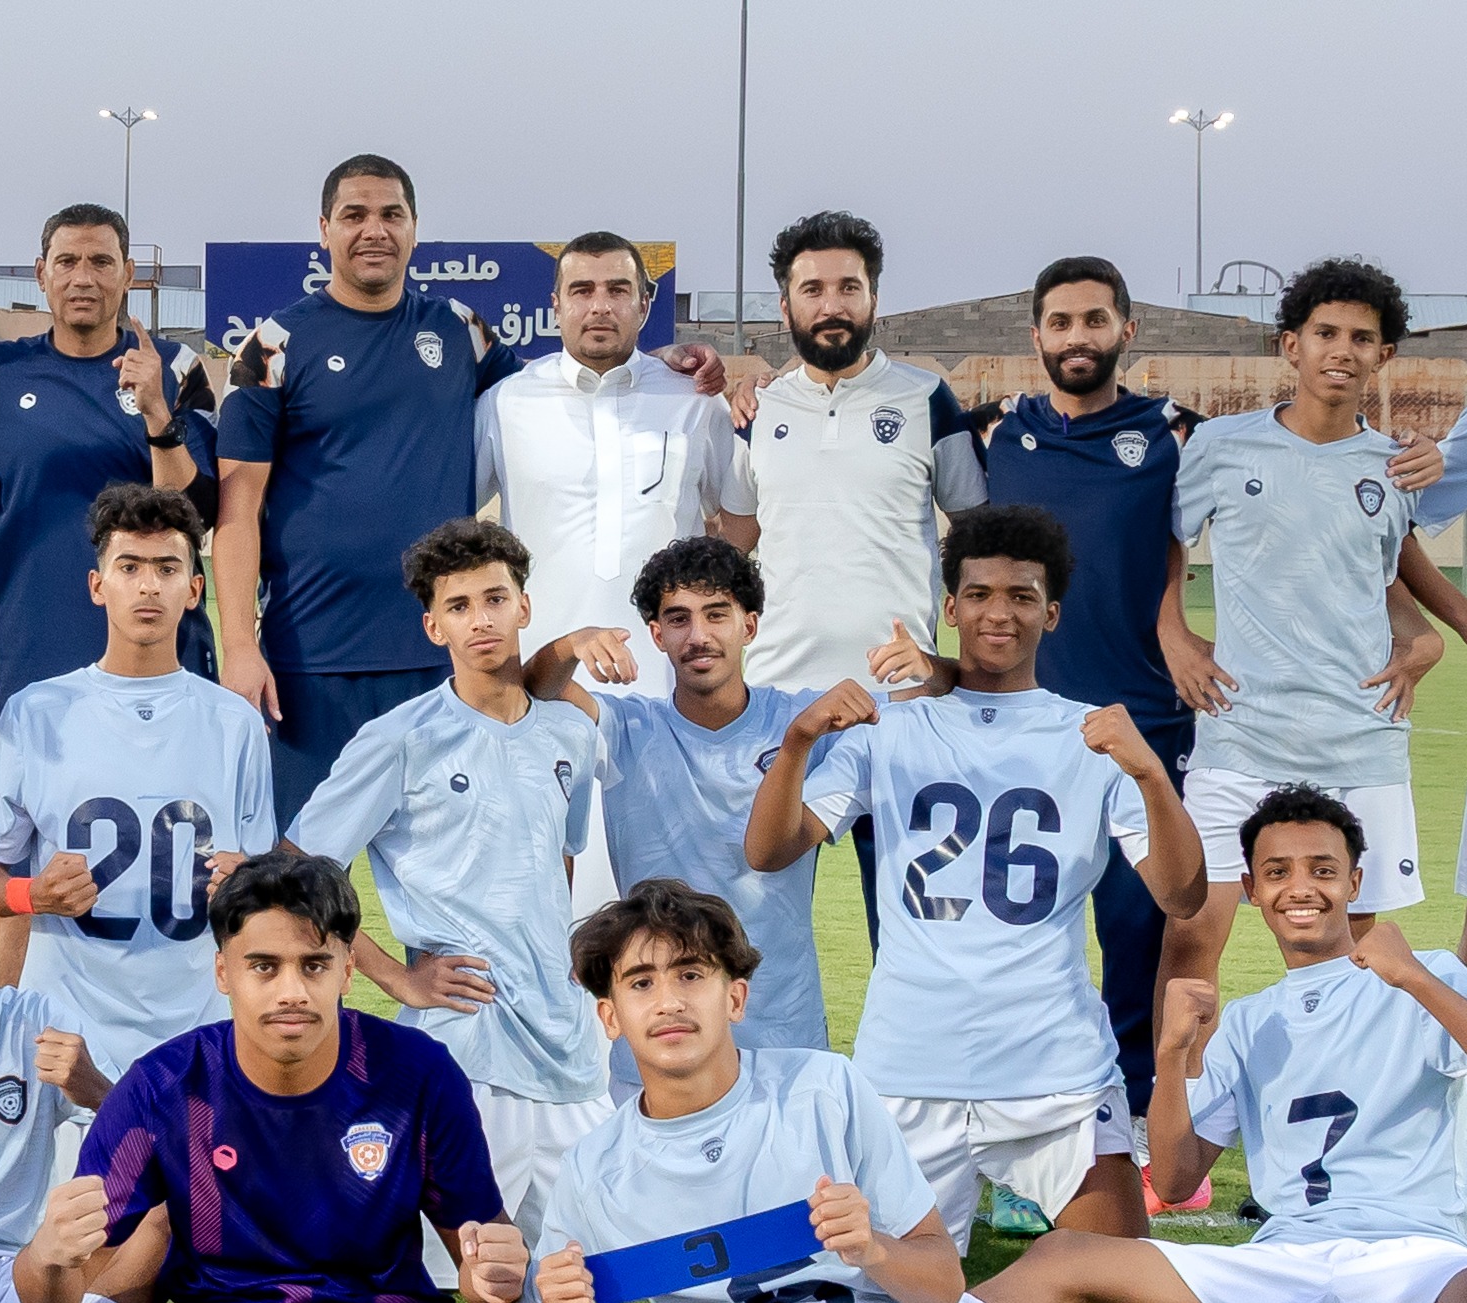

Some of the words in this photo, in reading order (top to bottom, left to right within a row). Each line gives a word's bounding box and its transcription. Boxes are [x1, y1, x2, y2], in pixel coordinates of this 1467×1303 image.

[409, 254, 500, 292] ملعب
[66, 796, 213, 942] 20
[902, 781, 1061, 926] 26
[1287, 1090, 1359, 1207] 7
